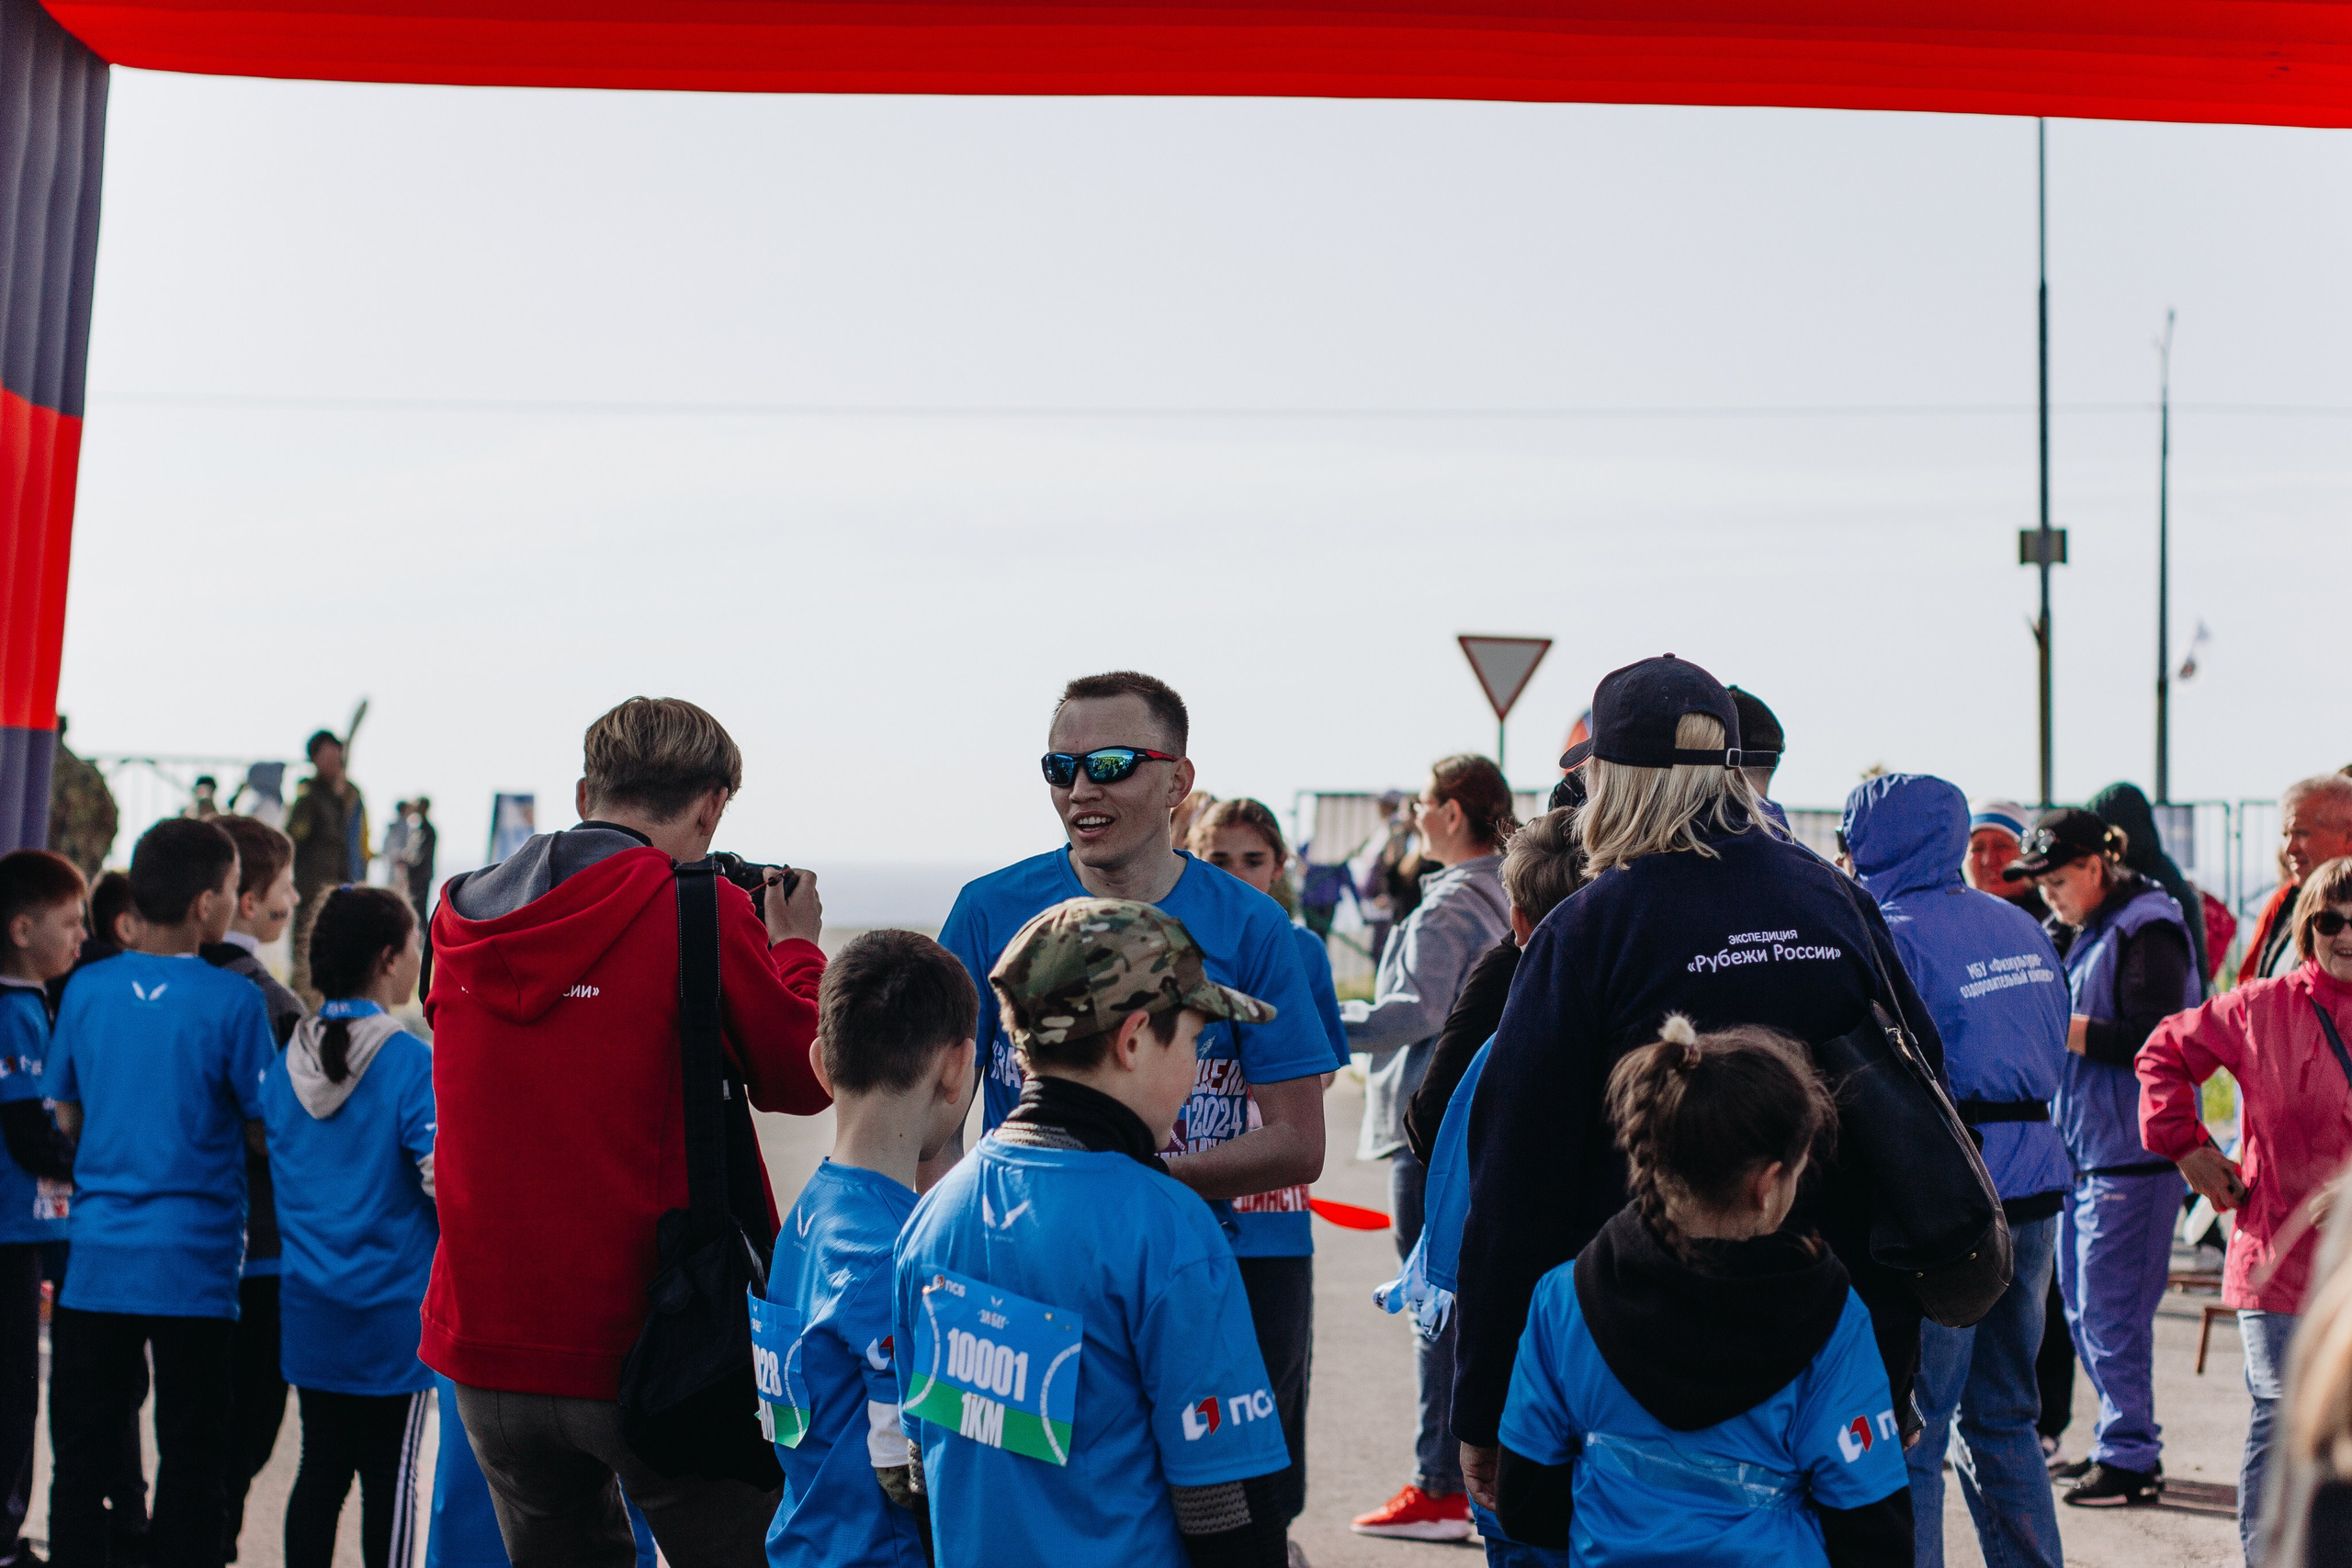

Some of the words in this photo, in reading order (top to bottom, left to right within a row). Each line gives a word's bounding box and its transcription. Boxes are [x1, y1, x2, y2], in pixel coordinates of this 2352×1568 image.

[1728, 930, 1798, 945] ЭКСПЕДИЦИЯ
[1687, 948, 1768, 973] «Рубежи
[1773, 944, 1841, 961] России»
[563, 985, 599, 998] ии»
[1189, 1095, 1243, 1139] 2024
[947, 1327, 1029, 1402] 10001
